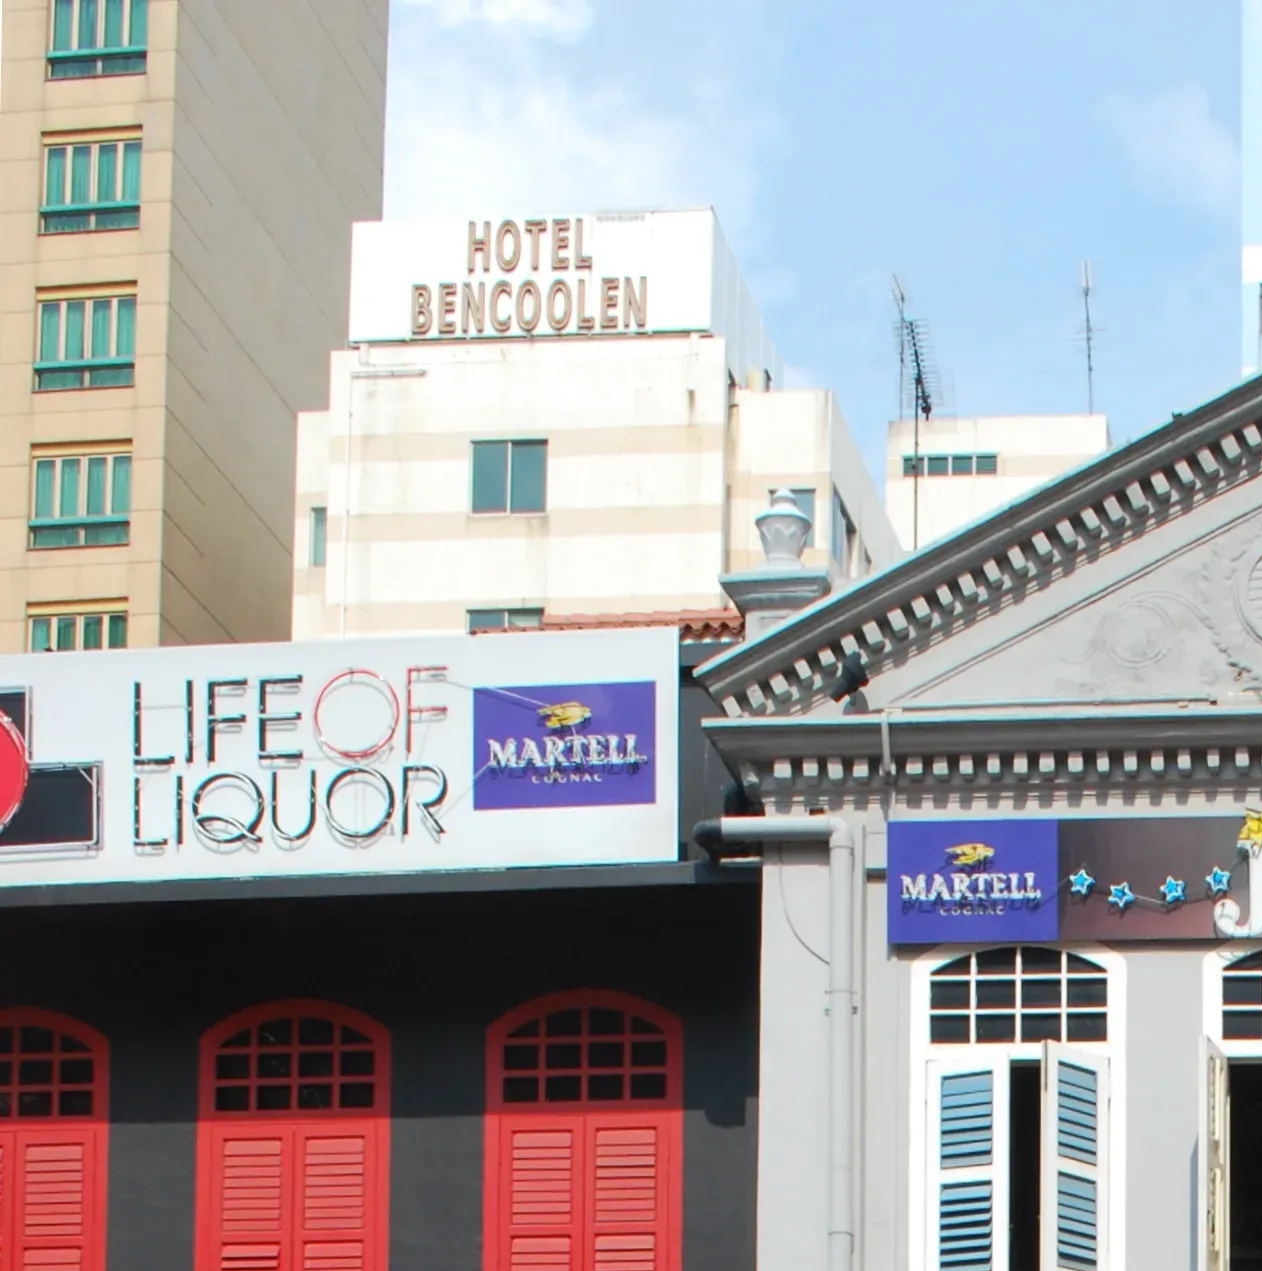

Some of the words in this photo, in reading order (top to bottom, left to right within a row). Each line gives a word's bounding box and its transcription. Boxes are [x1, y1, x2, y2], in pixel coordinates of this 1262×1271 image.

[466, 218, 592, 274] HOTEL
[411, 276, 648, 335] BENCOOLEN
[488, 733, 648, 769] MARTELL
[133, 764, 449, 846] LIQUOR
[901, 872, 1042, 901] MARTELL
[939, 904, 1005, 916] COGNAC
